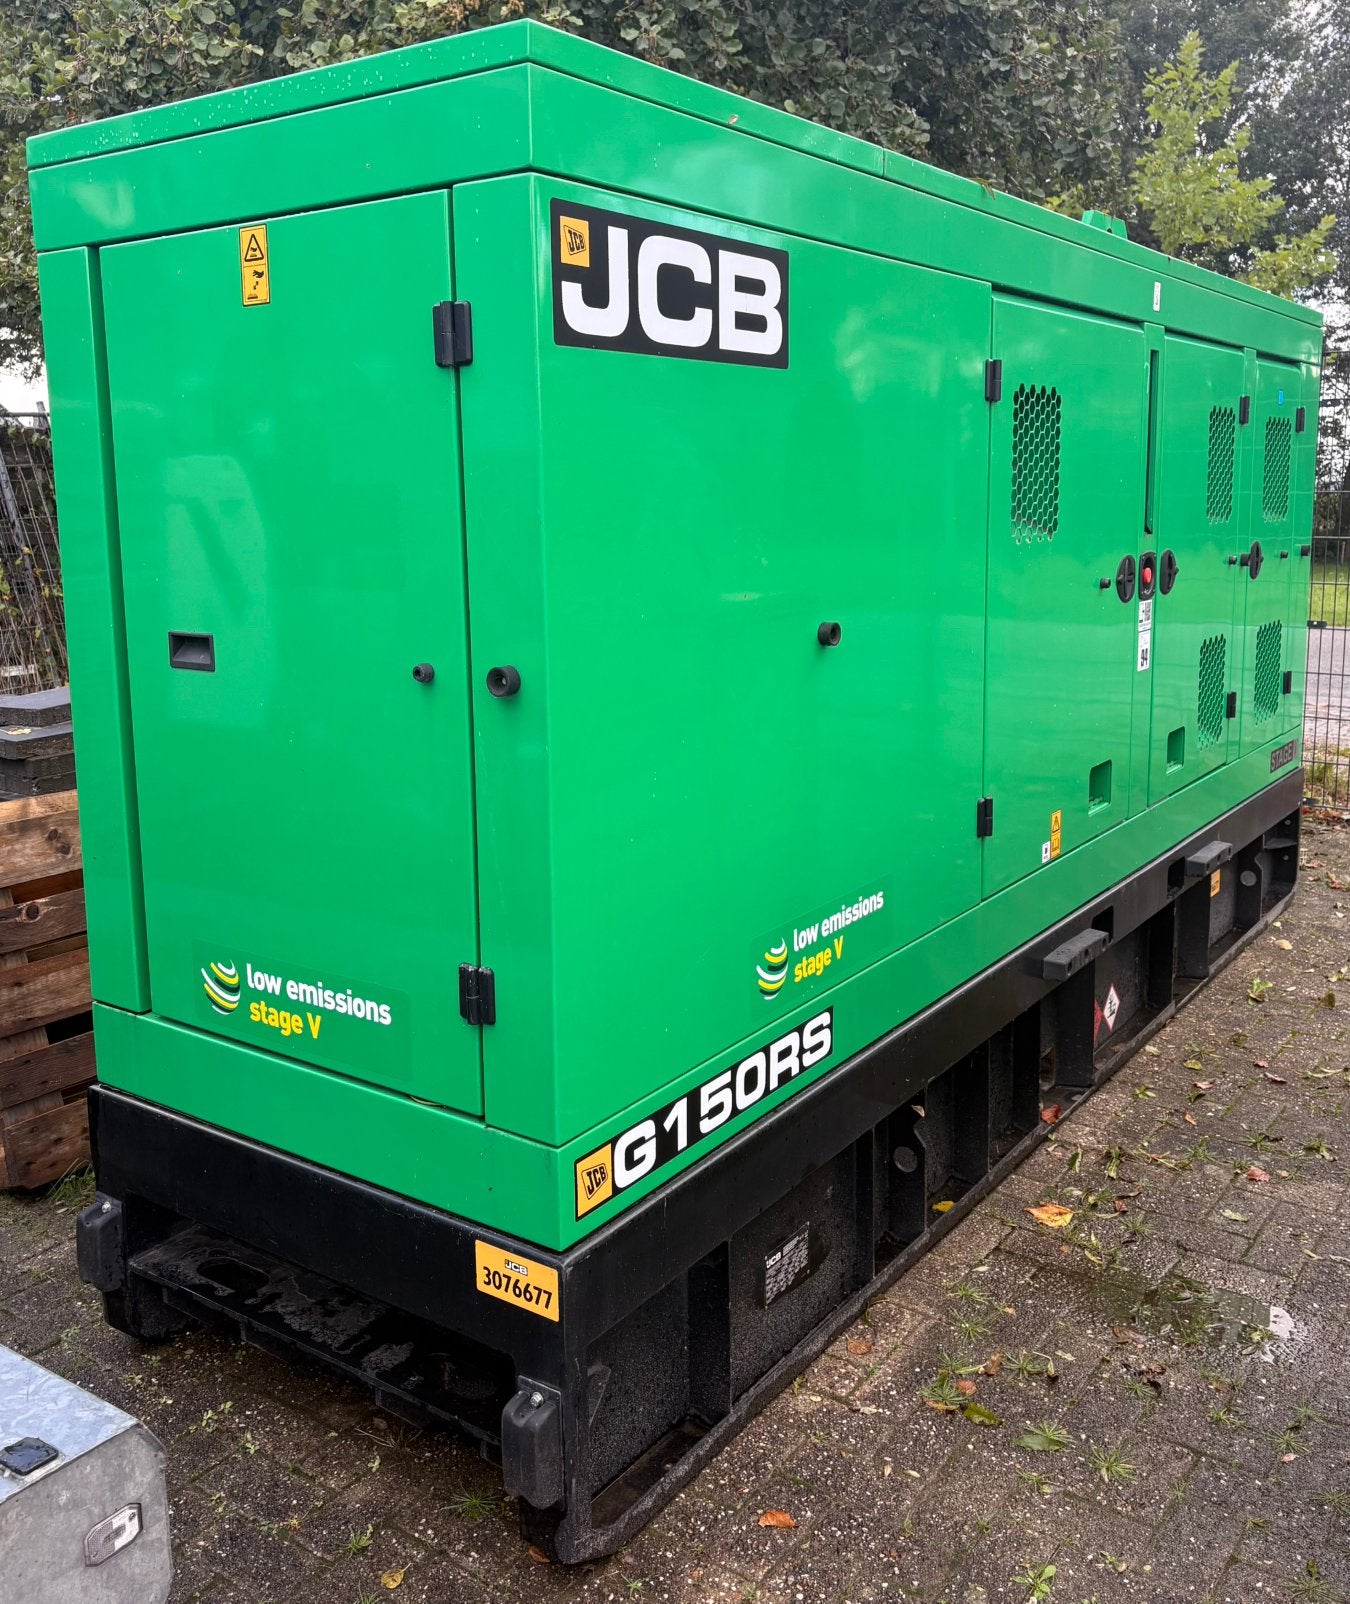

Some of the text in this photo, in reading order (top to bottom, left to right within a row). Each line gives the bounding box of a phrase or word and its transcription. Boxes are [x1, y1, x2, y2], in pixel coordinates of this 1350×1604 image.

[567, 229, 585, 252] JCB
[561, 225, 783, 355] JCB
[1140, 648, 1148, 667] 94
[794, 891, 884, 952] low emissions
[794, 935, 844, 983] stage V
[246, 963, 392, 1026] low emissions
[249, 1000, 322, 1040] stage V
[613, 1011, 832, 1189] G150RS
[586, 1165, 607, 1196] JCB
[505, 1260, 528, 1276] JCB
[766, 1251, 782, 1269] JCB
[483, 1265, 553, 1310] 3076677
